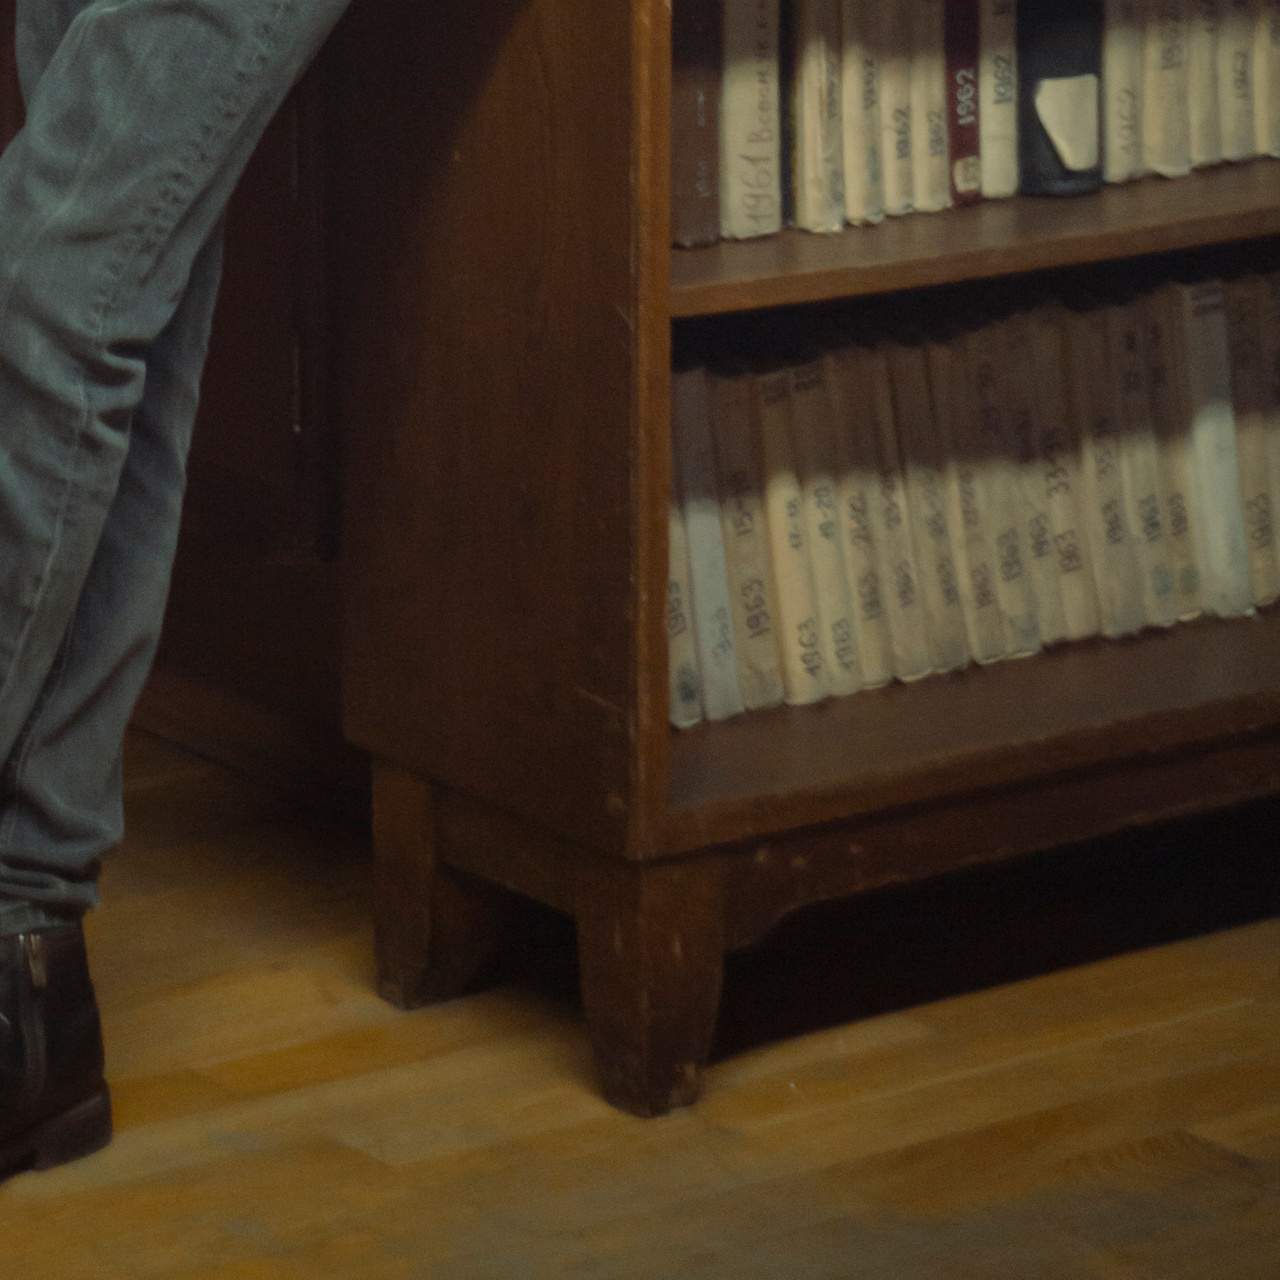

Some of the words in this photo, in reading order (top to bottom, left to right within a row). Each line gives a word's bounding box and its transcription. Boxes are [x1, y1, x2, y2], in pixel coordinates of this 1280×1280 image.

[956, 68, 976, 126] 1962
[993, 54, 1013, 106] 1962
[738, 154, 773, 224] 1961
[740, 577, 770, 640] 1963
